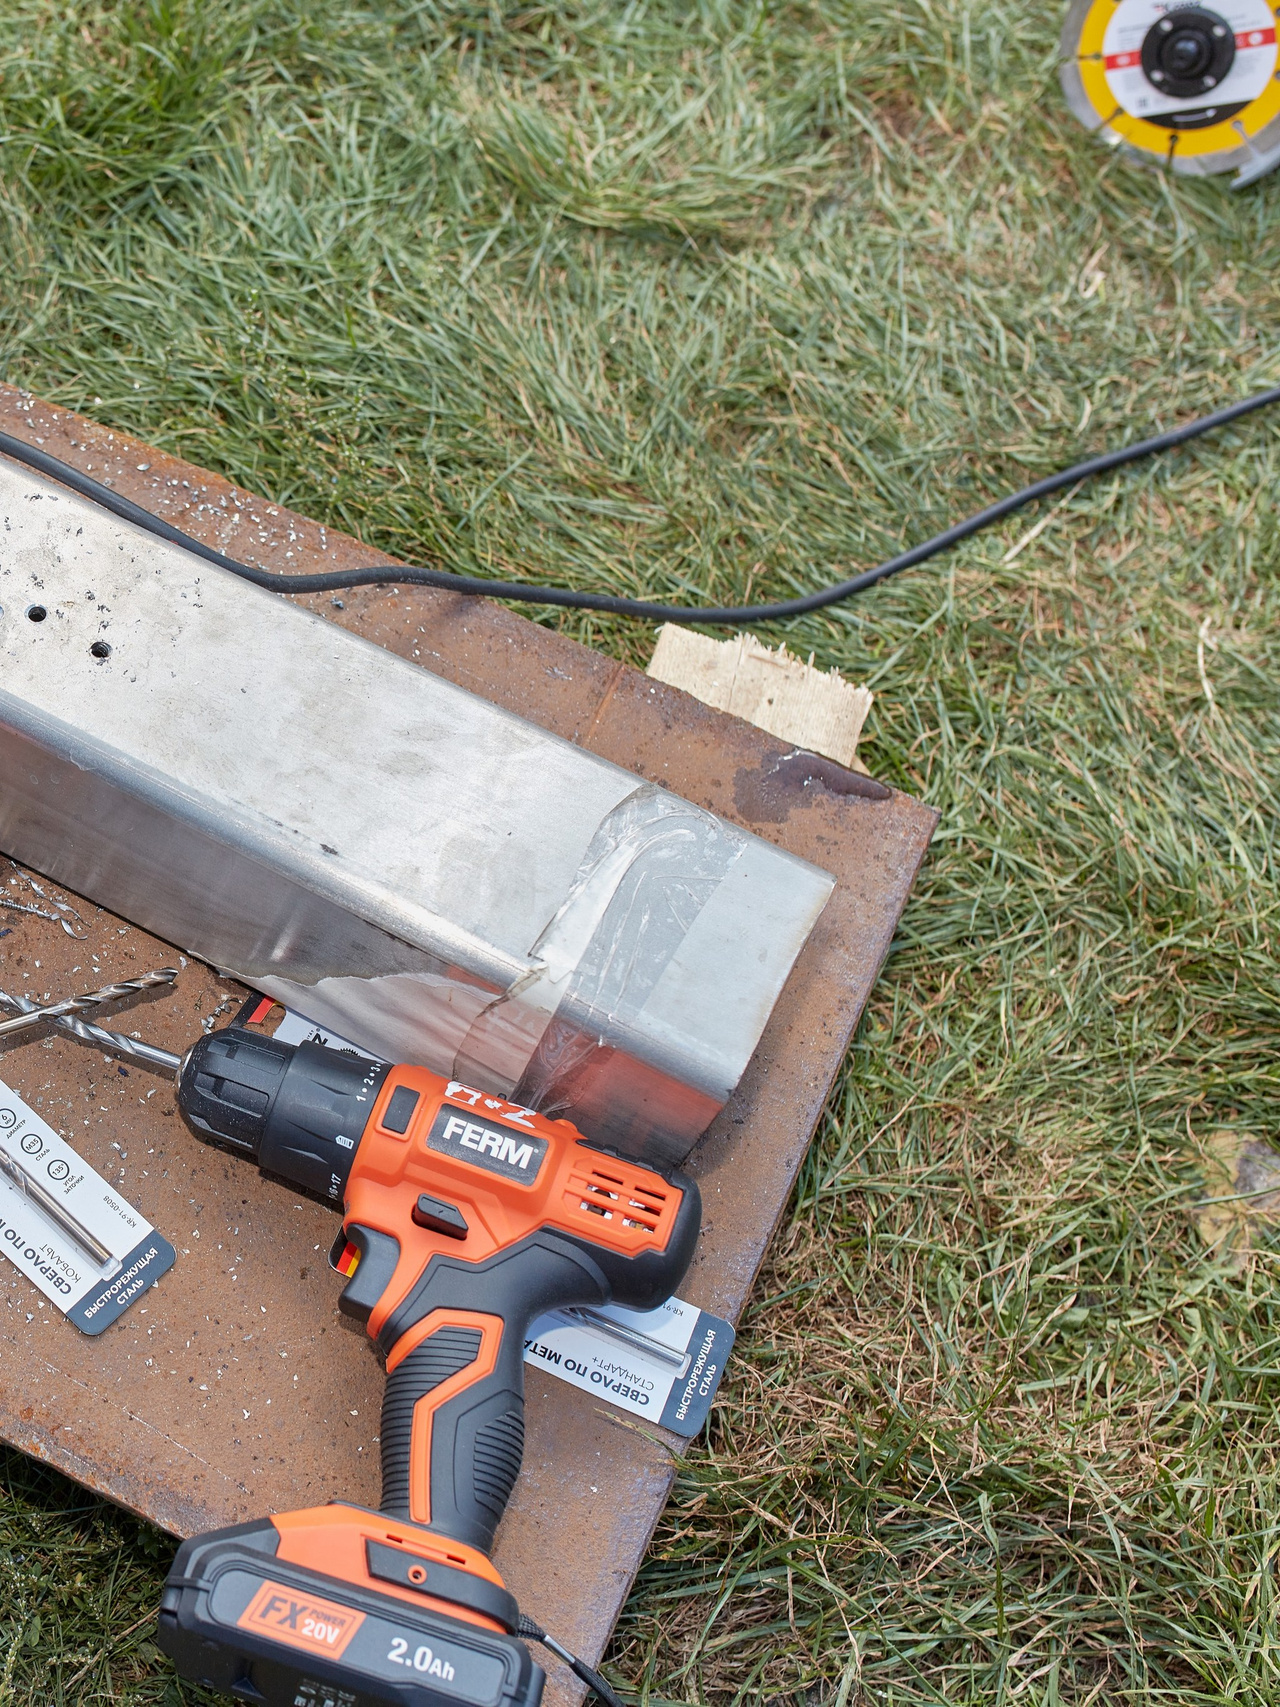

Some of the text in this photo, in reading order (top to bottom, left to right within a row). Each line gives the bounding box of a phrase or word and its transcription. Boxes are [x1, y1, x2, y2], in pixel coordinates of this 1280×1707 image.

[6, 1119, 26, 1139] ДИАМЕТР
[442, 1115, 534, 1169] FERM
[35, 1148, 51, 1162] СТАЛЬ
[62, 1174, 76, 1187] УГОЛ
[63, 1175, 85, 1195] ЗАТОЧКИ
[330, 1172, 342, 1185] 17
[4, 1228, 26, 1250] ПО
[23, 1248, 72, 1294] СВЕРЛО
[39, 1243, 82, 1284] КОБАЛЬТ
[83, 1247, 159, 1319] БЫСТРОРЕЖУЩАЯ
[116, 1279, 144, 1305] СТАЛЬ
[564, 1358, 588, 1377] ПО
[592, 1356, 655, 1391] СТАНДАРТ+
[675, 1329, 717, 1421] БЫСТРОРЕЖУЩАЯ
[698, 1363, 717, 1397] СТАЛЬ
[590, 1371, 650, 1406] СВЕРЛО
[259, 1595, 346, 1631] FX POWER
[301, 1618, 340, 1644] 20V
[387, 1637, 456, 1682] 2.0Ah
